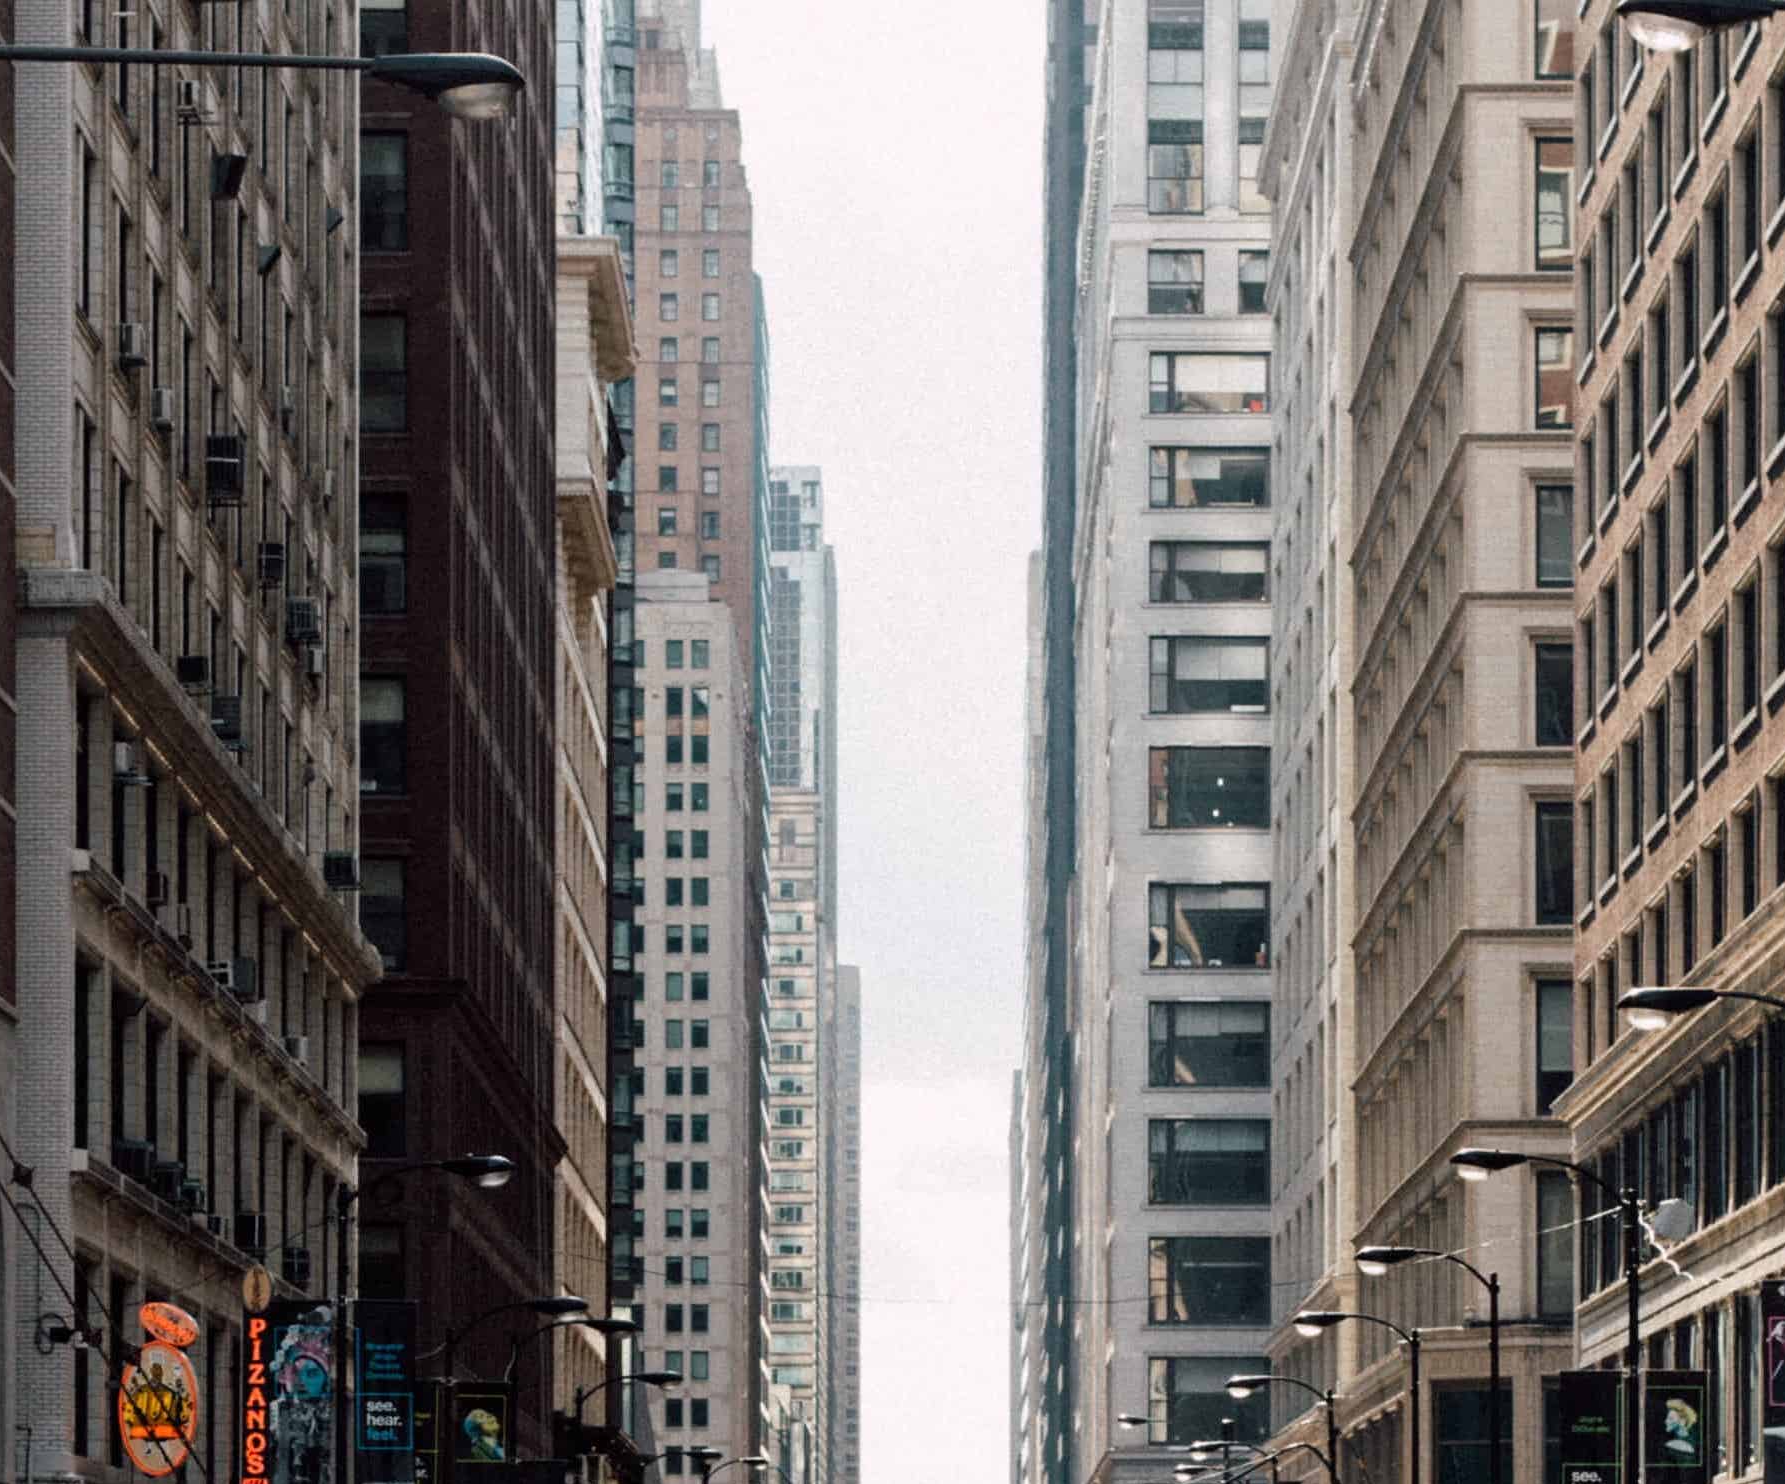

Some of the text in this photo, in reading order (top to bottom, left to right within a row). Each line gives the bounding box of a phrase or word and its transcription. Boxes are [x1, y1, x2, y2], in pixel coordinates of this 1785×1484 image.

[367, 1401, 397, 1412] see.
[367, 1413, 403, 1427] hear.
[1571, 1471, 1602, 1482] see.
